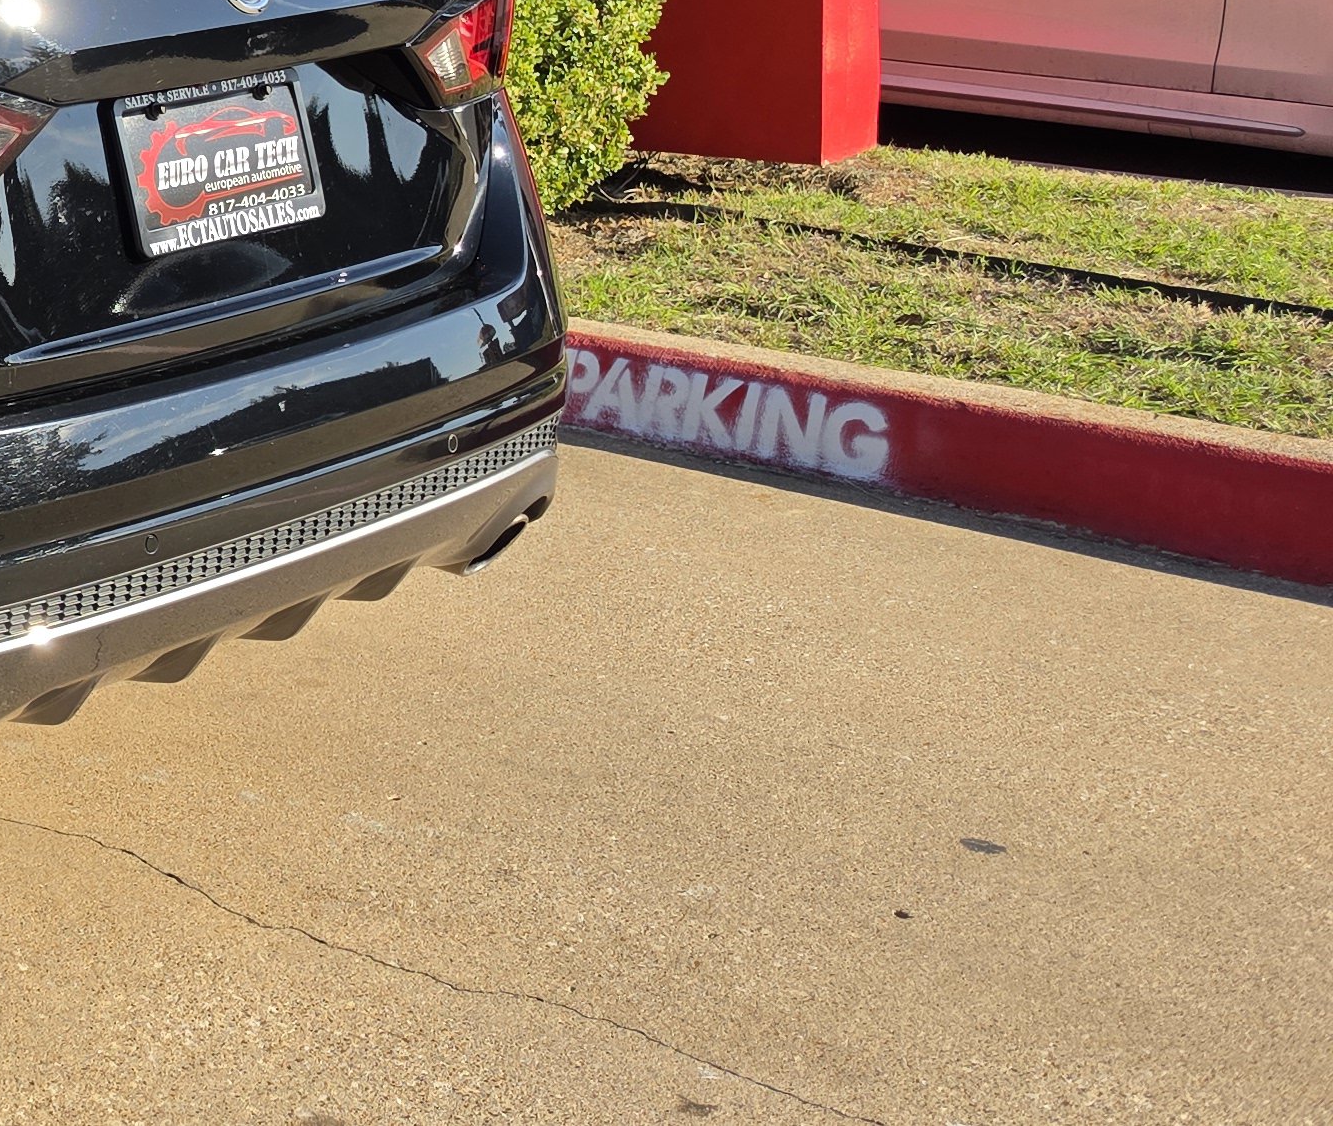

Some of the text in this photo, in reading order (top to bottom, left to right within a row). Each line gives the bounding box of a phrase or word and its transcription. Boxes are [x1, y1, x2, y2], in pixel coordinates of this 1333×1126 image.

[124, 69, 286, 110] SALES & SERVICE 817-404-4033
[157, 136, 300, 191] EURO CAR TECH
[204, 162, 303, 192] european automotive
[208, 183, 306, 216] 817-404-4033
[149, 200, 321, 257] www.ECTAUTOSALES.com
[566, 348, 890, 486] PARKING
